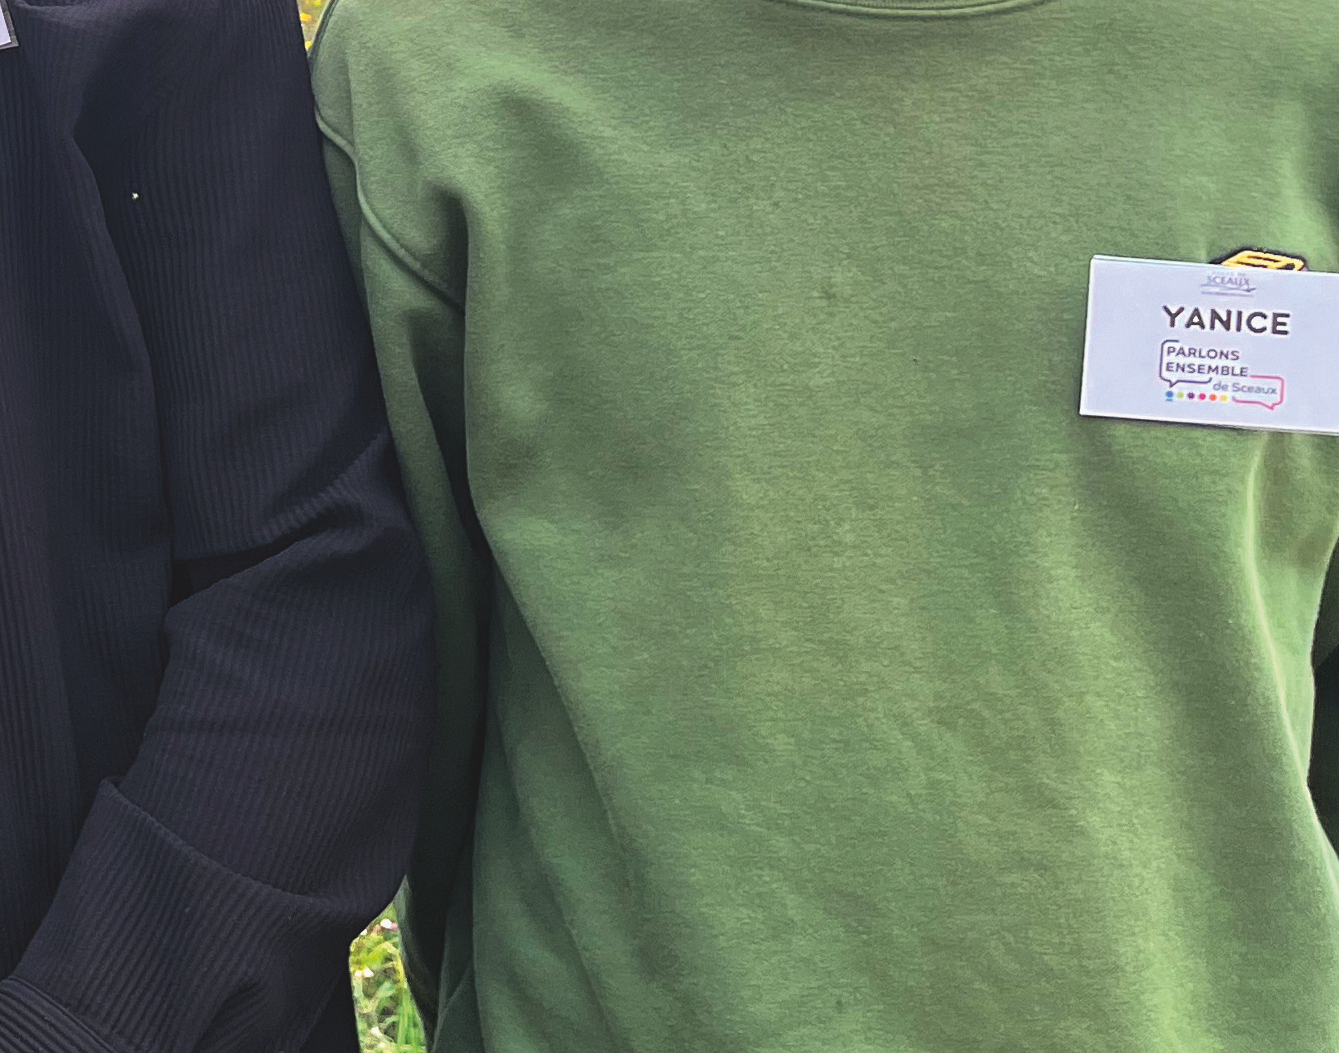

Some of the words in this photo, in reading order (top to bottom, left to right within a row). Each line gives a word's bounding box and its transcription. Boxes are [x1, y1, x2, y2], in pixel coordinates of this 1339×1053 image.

[1162, 305, 1291, 336] YANICE
[1166, 346, 1240, 361] PARLONS
[1165, 362, 1249, 377] ENSEMBLE
[1213, 382, 1228, 392] de
[1231, 382, 1278, 395] Sceaux
